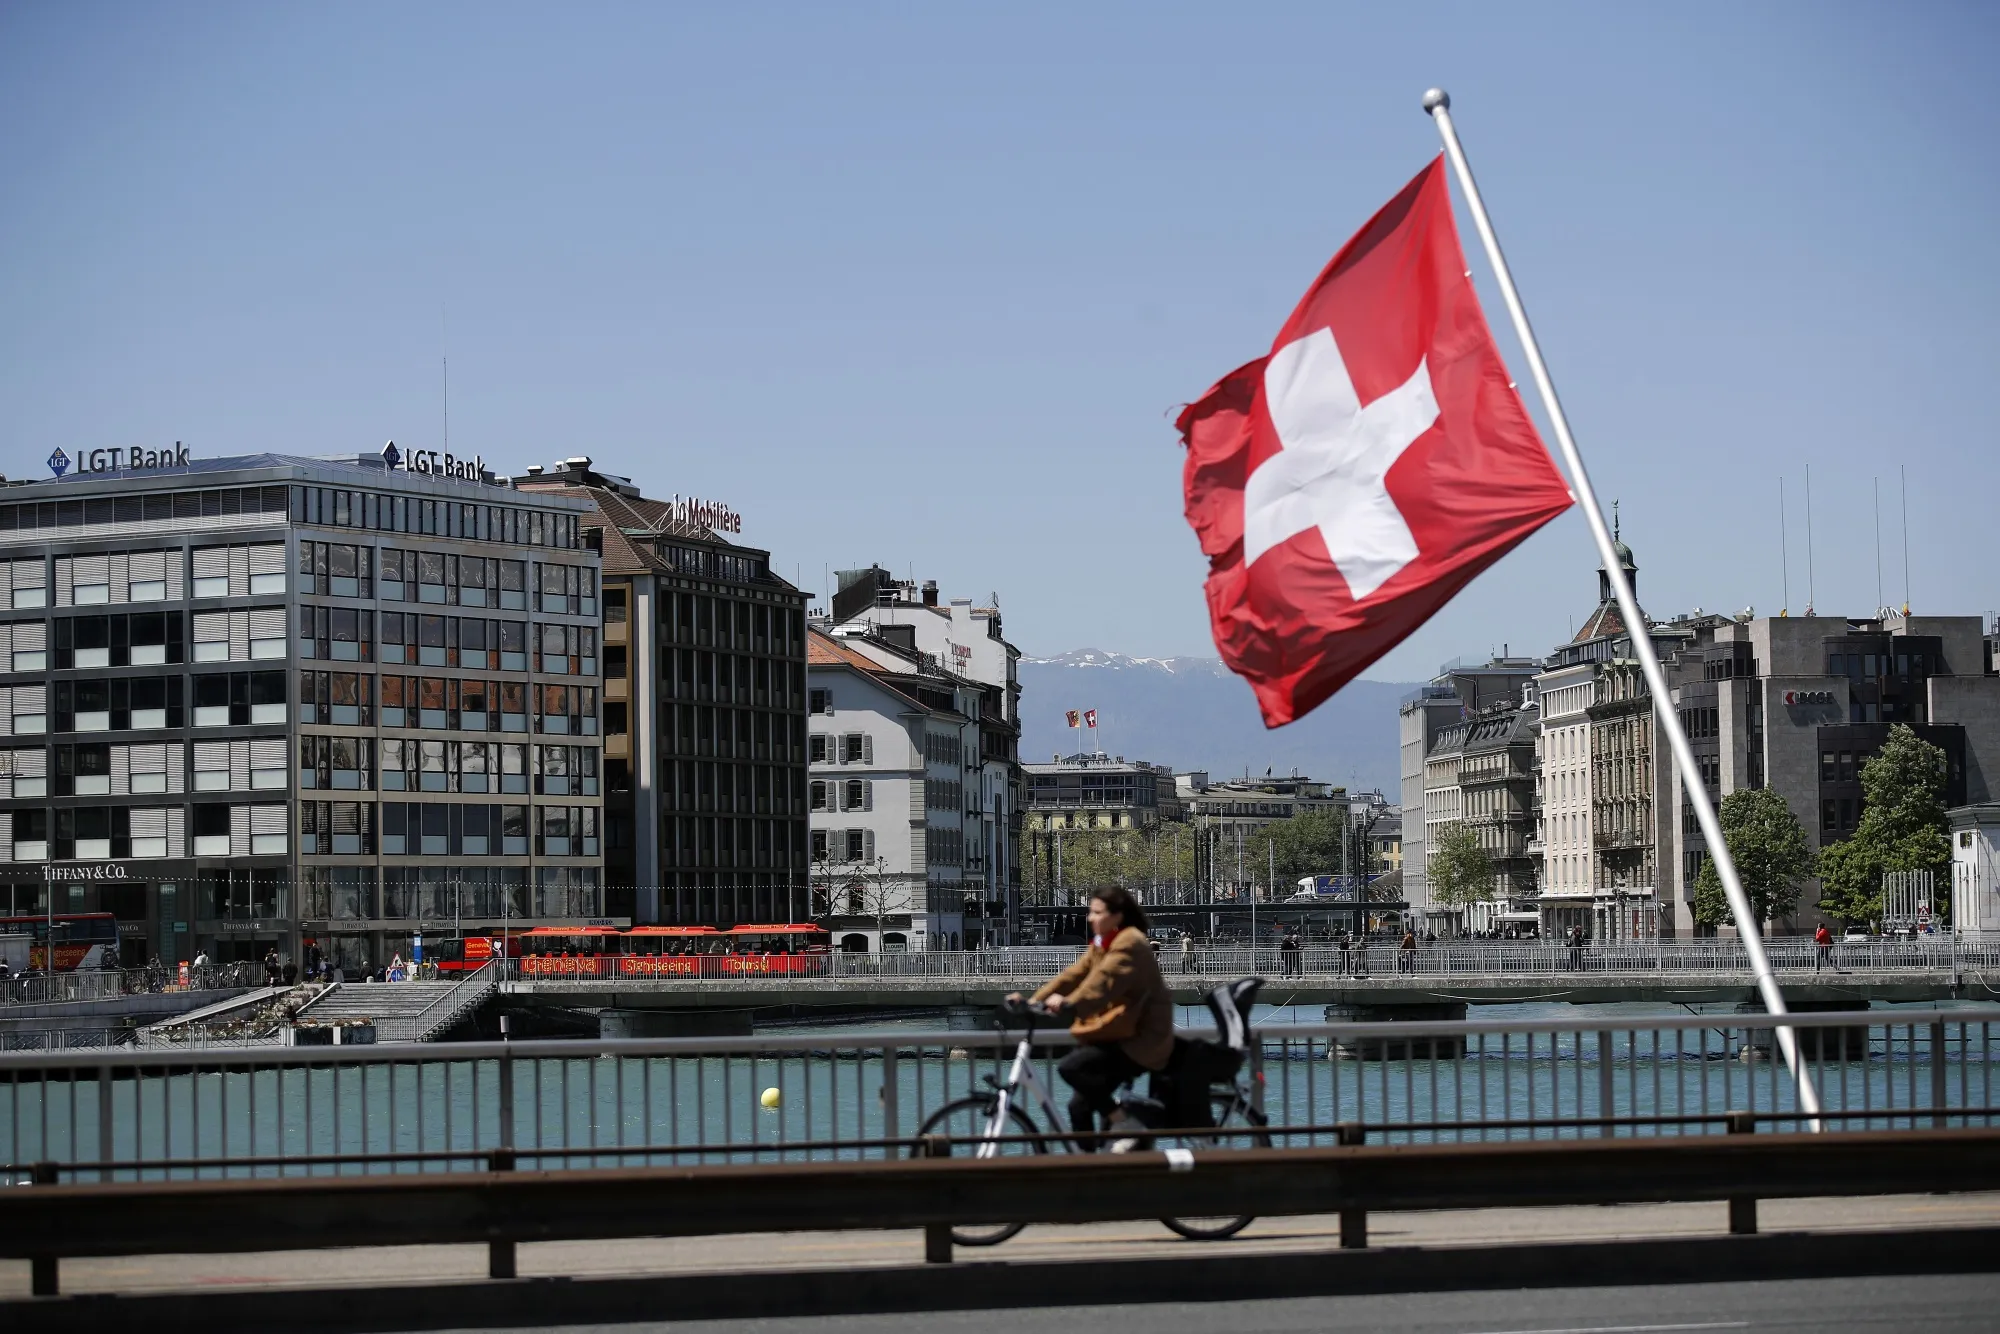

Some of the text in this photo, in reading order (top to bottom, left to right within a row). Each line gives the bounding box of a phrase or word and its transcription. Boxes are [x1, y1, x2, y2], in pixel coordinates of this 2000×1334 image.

[51, 457, 67, 468] LGT
[78, 441, 190, 473] LGT Bank
[404, 448, 485, 481] LGT Bank
[686, 497, 741, 533] Mobilière
